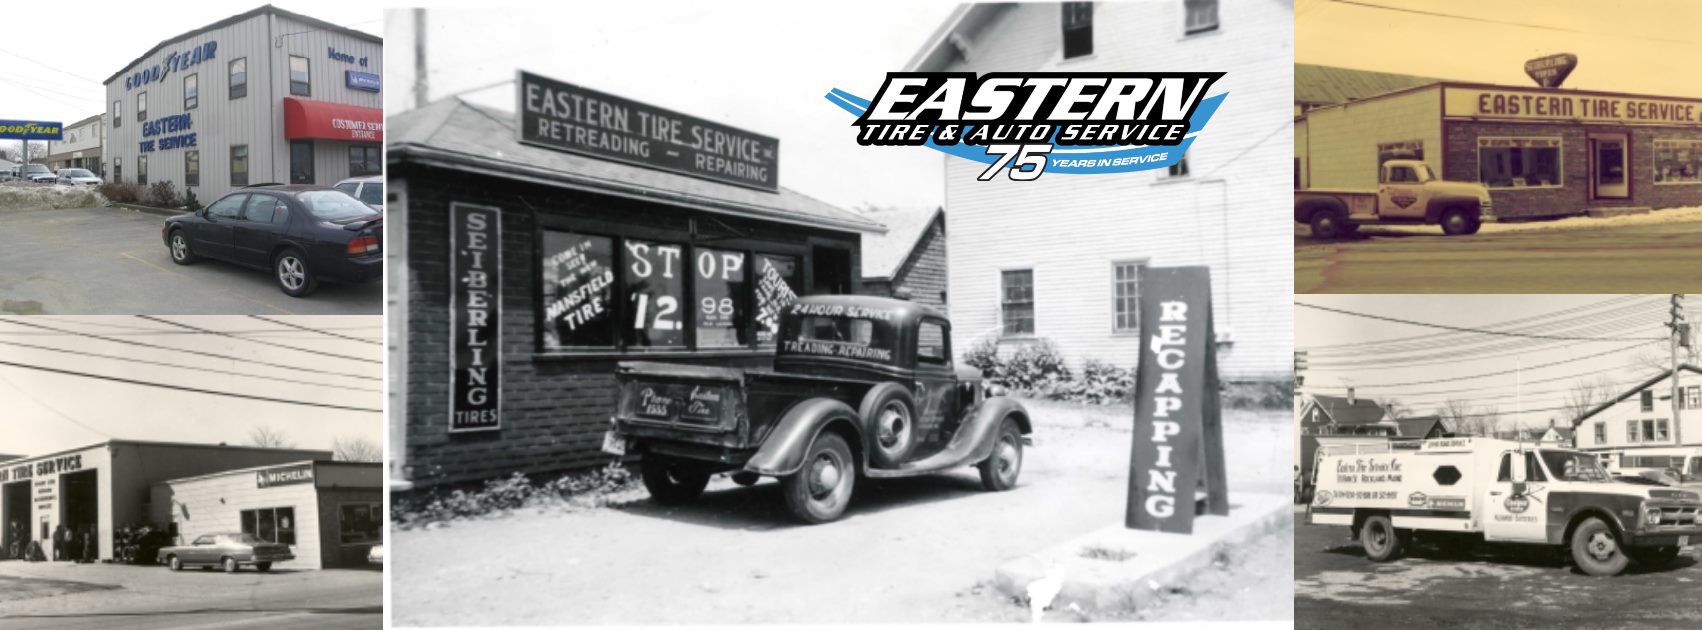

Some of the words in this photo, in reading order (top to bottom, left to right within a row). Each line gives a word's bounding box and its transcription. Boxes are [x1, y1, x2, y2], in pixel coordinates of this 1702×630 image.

[125, 40, 218, 91] GOODYEAR
[327, 46, 355, 64] Home
[1479, 93, 1574, 116] EASTERN
[1580, 98, 1620, 118] TIRE
[1626, 101, 1694, 121] SERVICE
[0, 123, 59, 135] OODYEAR
[143, 113, 192, 137] EASTERN
[526, 83, 630, 133] EASTERN
[638, 110, 683, 144] TIRE
[691, 125, 761, 164] SERVICE
[159, 132, 197, 150] SERVICE
[538, 118, 649, 158] RETREADING
[695, 152, 768, 182] REPAIRING
[546, 270, 614, 322] MANSFIELD
[701, 296, 734, 315] 98
[466, 212, 488, 405] SEIBERLING
[563, 296, 604, 331] TIRE
[790, 304, 808, 315] 24
[809, 304, 843, 317] HOUR
[846, 307, 891, 320] SERVICE
[456, 408, 497, 424] TIRES
[1145, 301, 1188, 518] RECAPPING
[37, 454, 82, 476] SERVICE
[268, 470, 312, 482] MICHELIN
